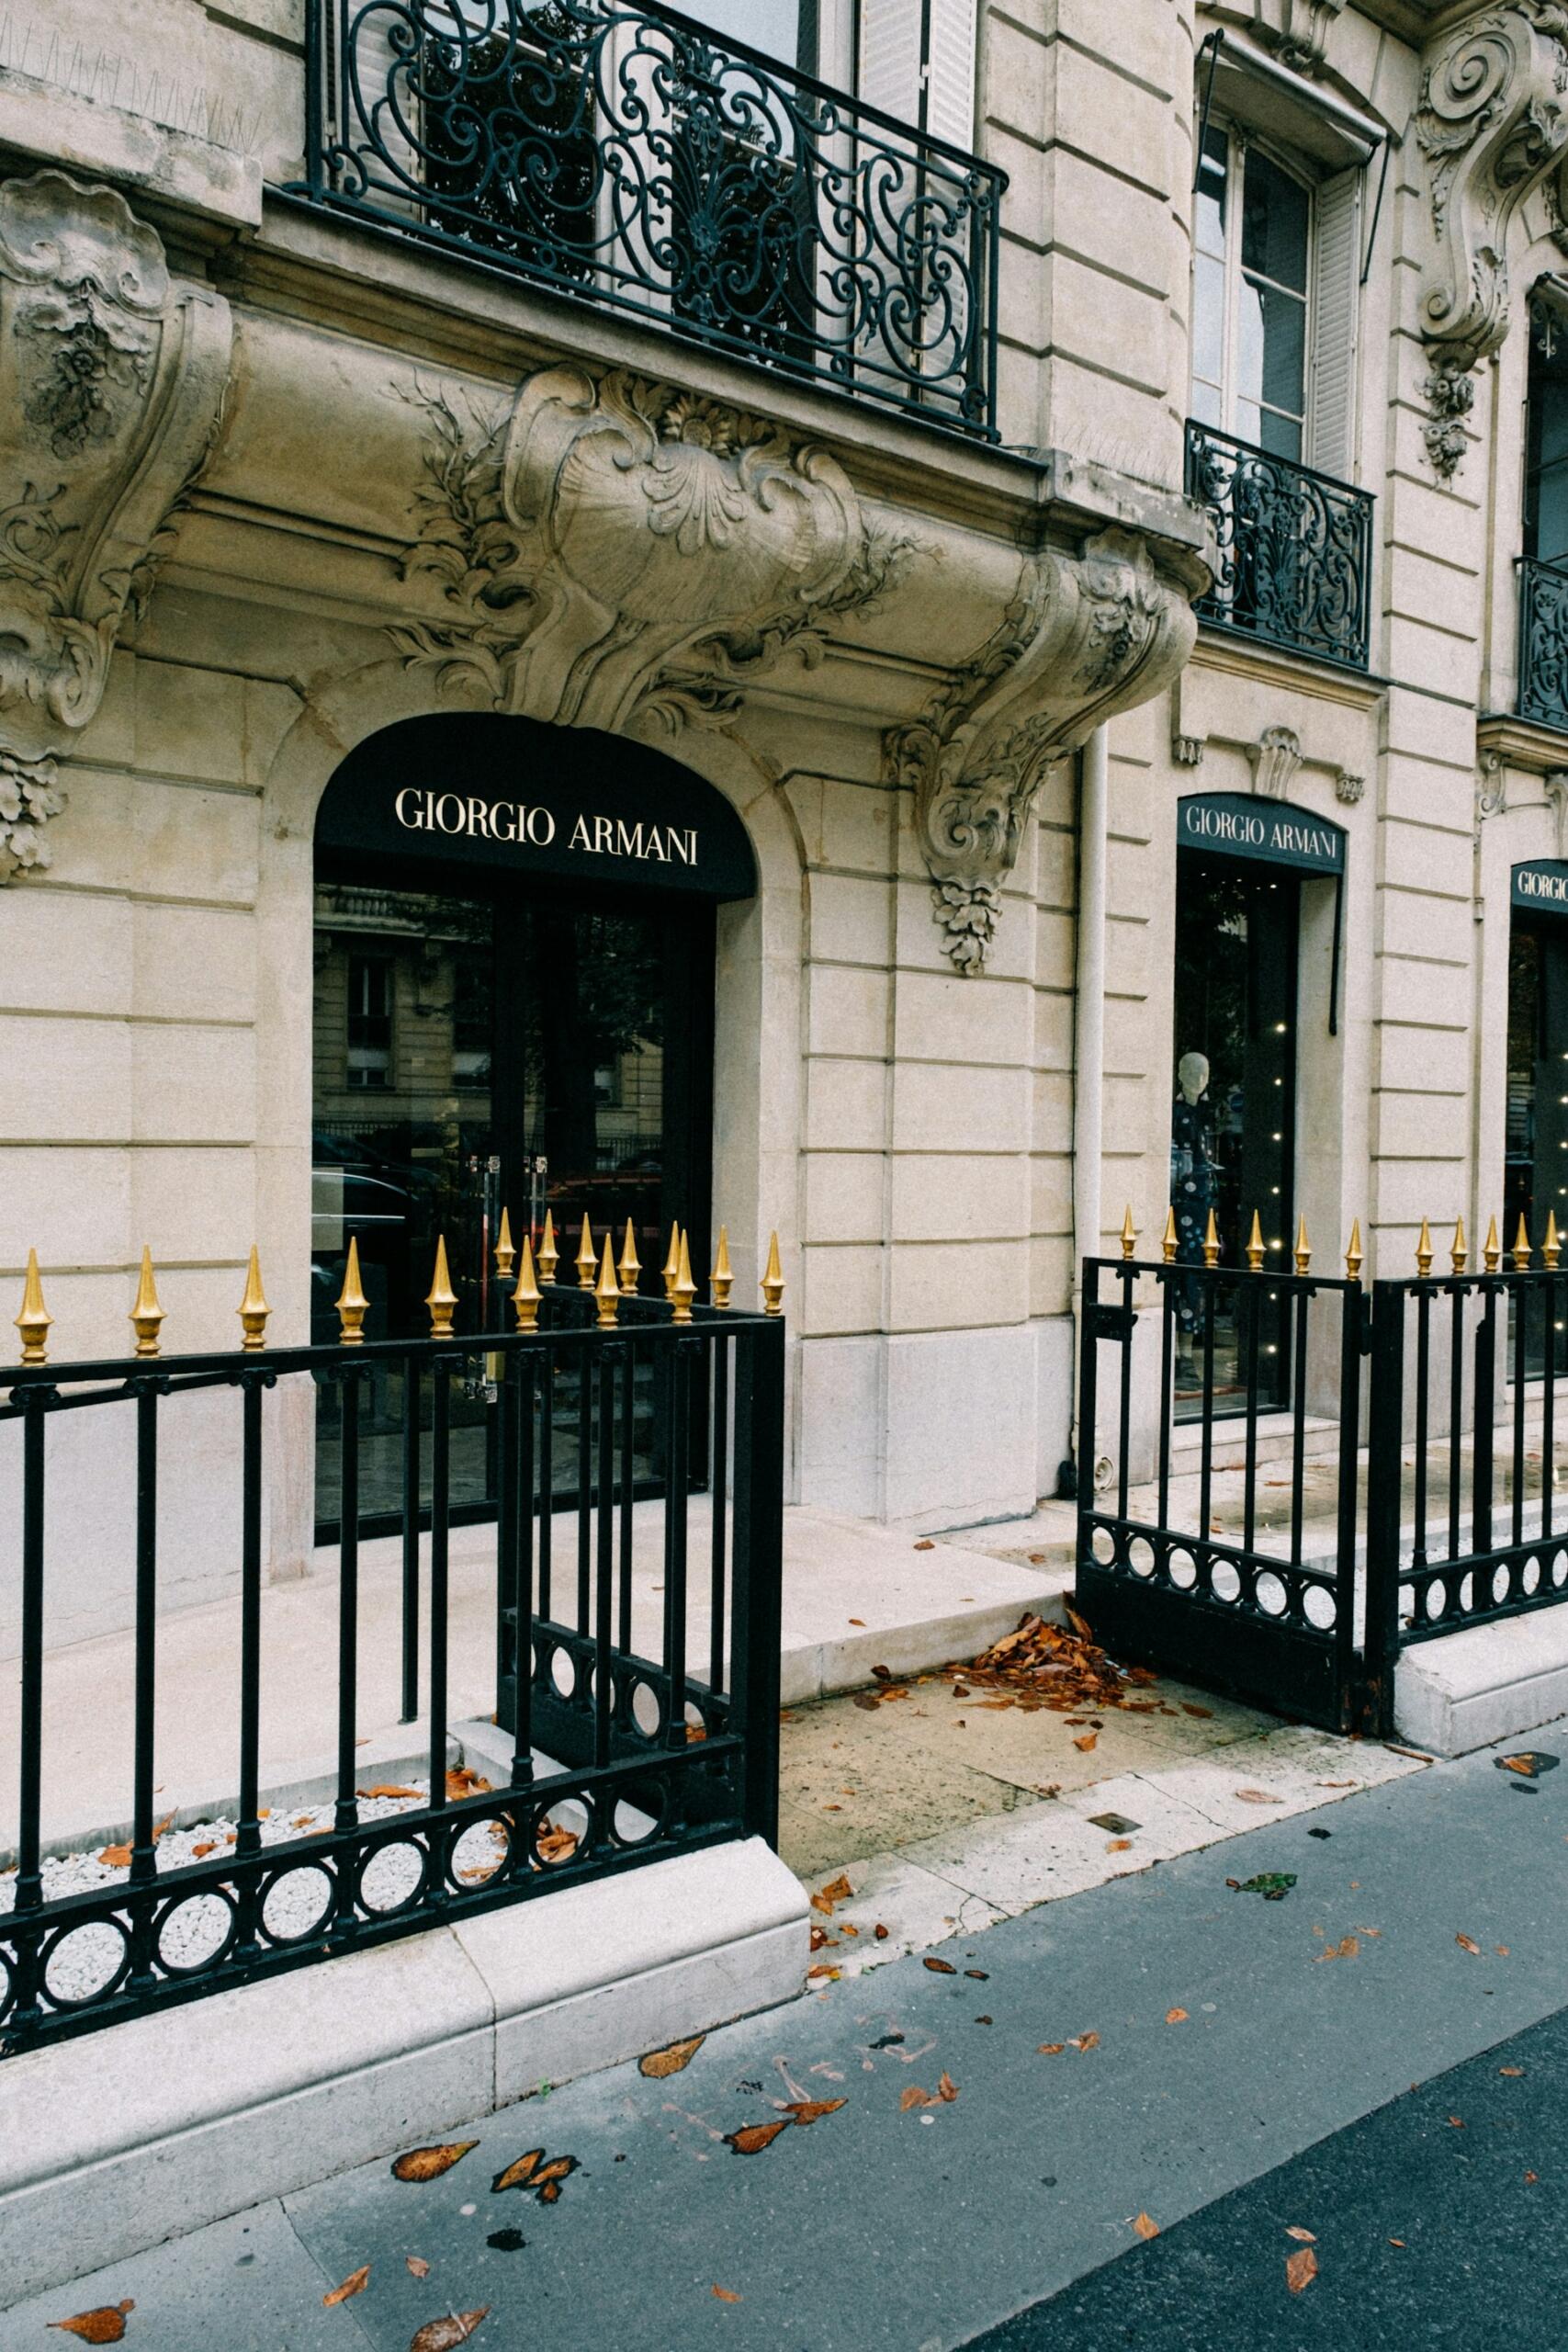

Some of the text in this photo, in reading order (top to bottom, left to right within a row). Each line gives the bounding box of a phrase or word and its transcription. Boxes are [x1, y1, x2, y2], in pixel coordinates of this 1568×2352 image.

[395, 788, 698, 865] GIORGIO ARMANI
[1186, 806, 1337, 858] GIORGIO ARMANI
